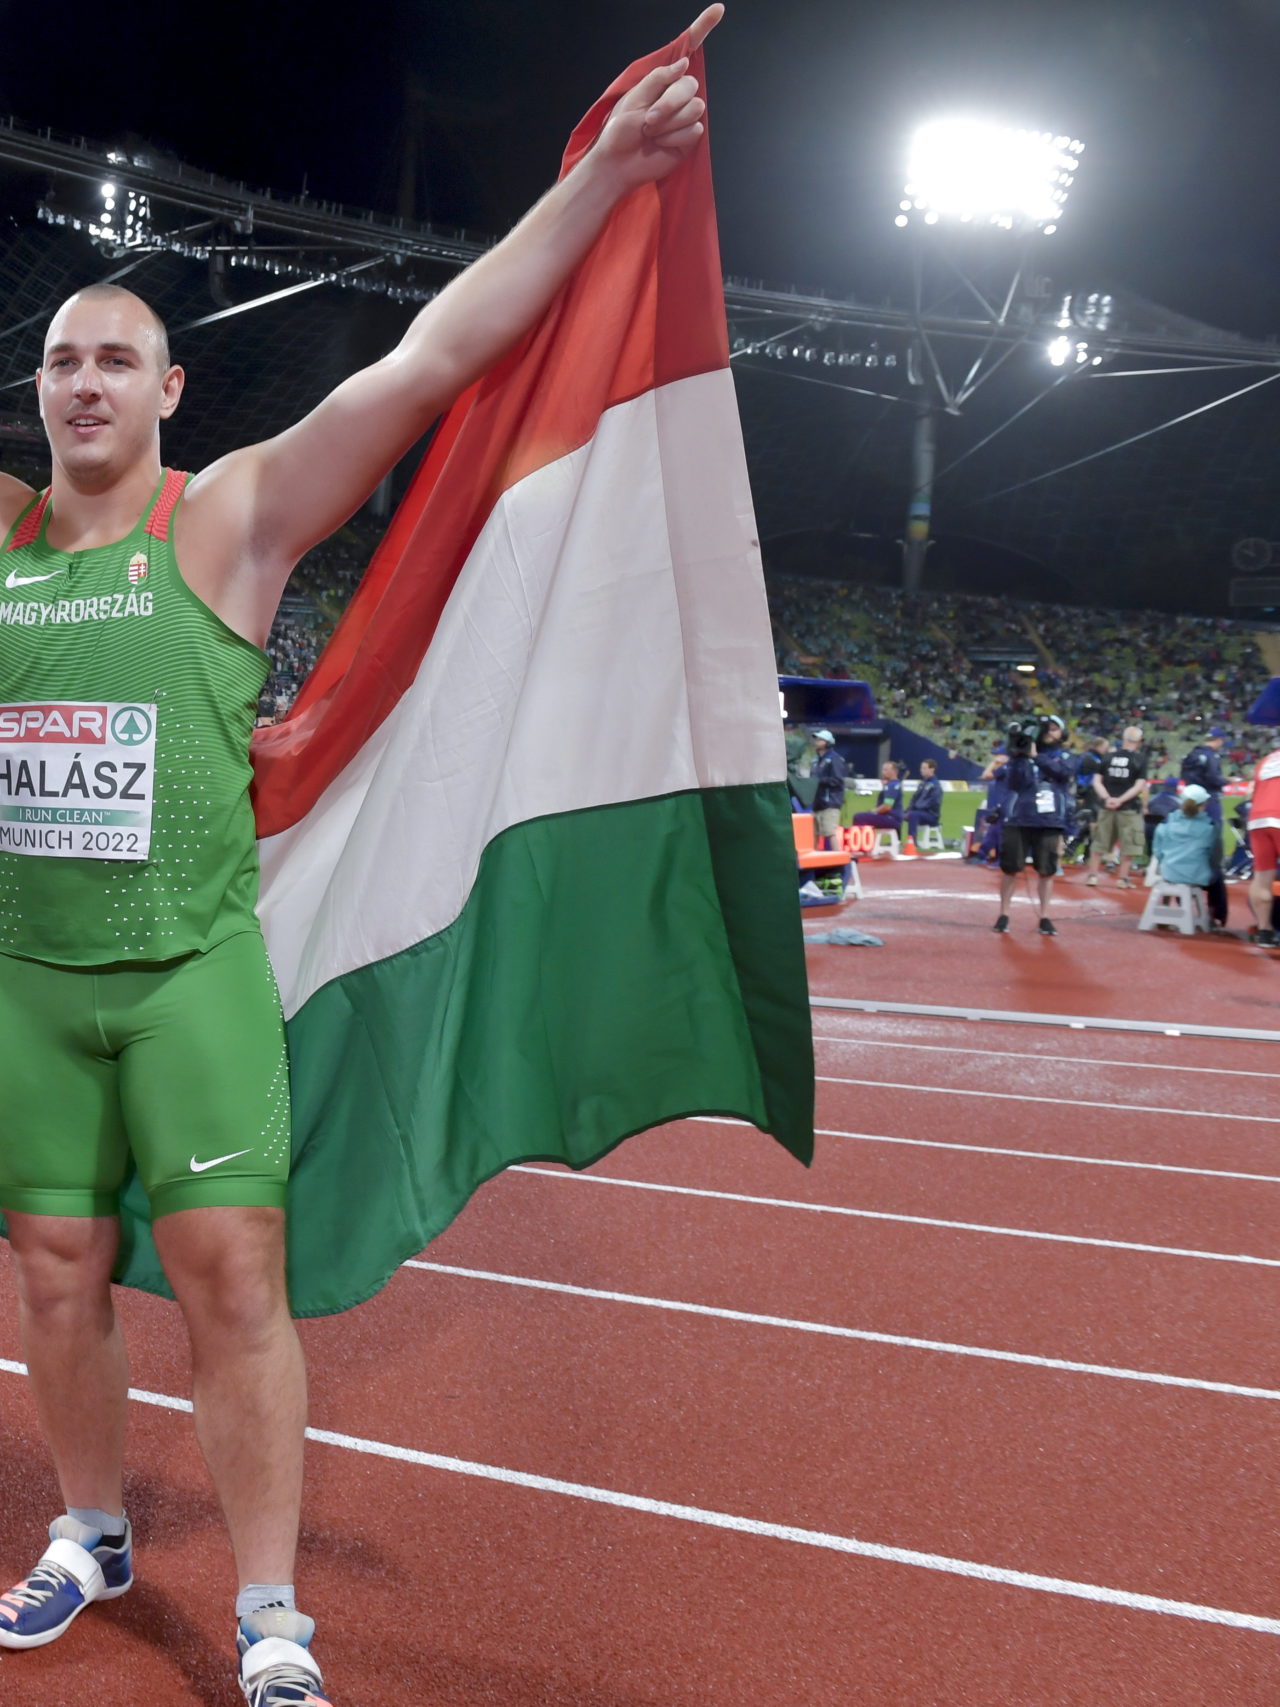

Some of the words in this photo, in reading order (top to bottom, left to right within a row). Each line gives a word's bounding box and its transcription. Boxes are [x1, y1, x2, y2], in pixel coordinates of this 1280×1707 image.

[25, 809, 52, 822] RUN
[0, 826, 73, 850] MUNICH
[82, 831, 138, 853] 2022
